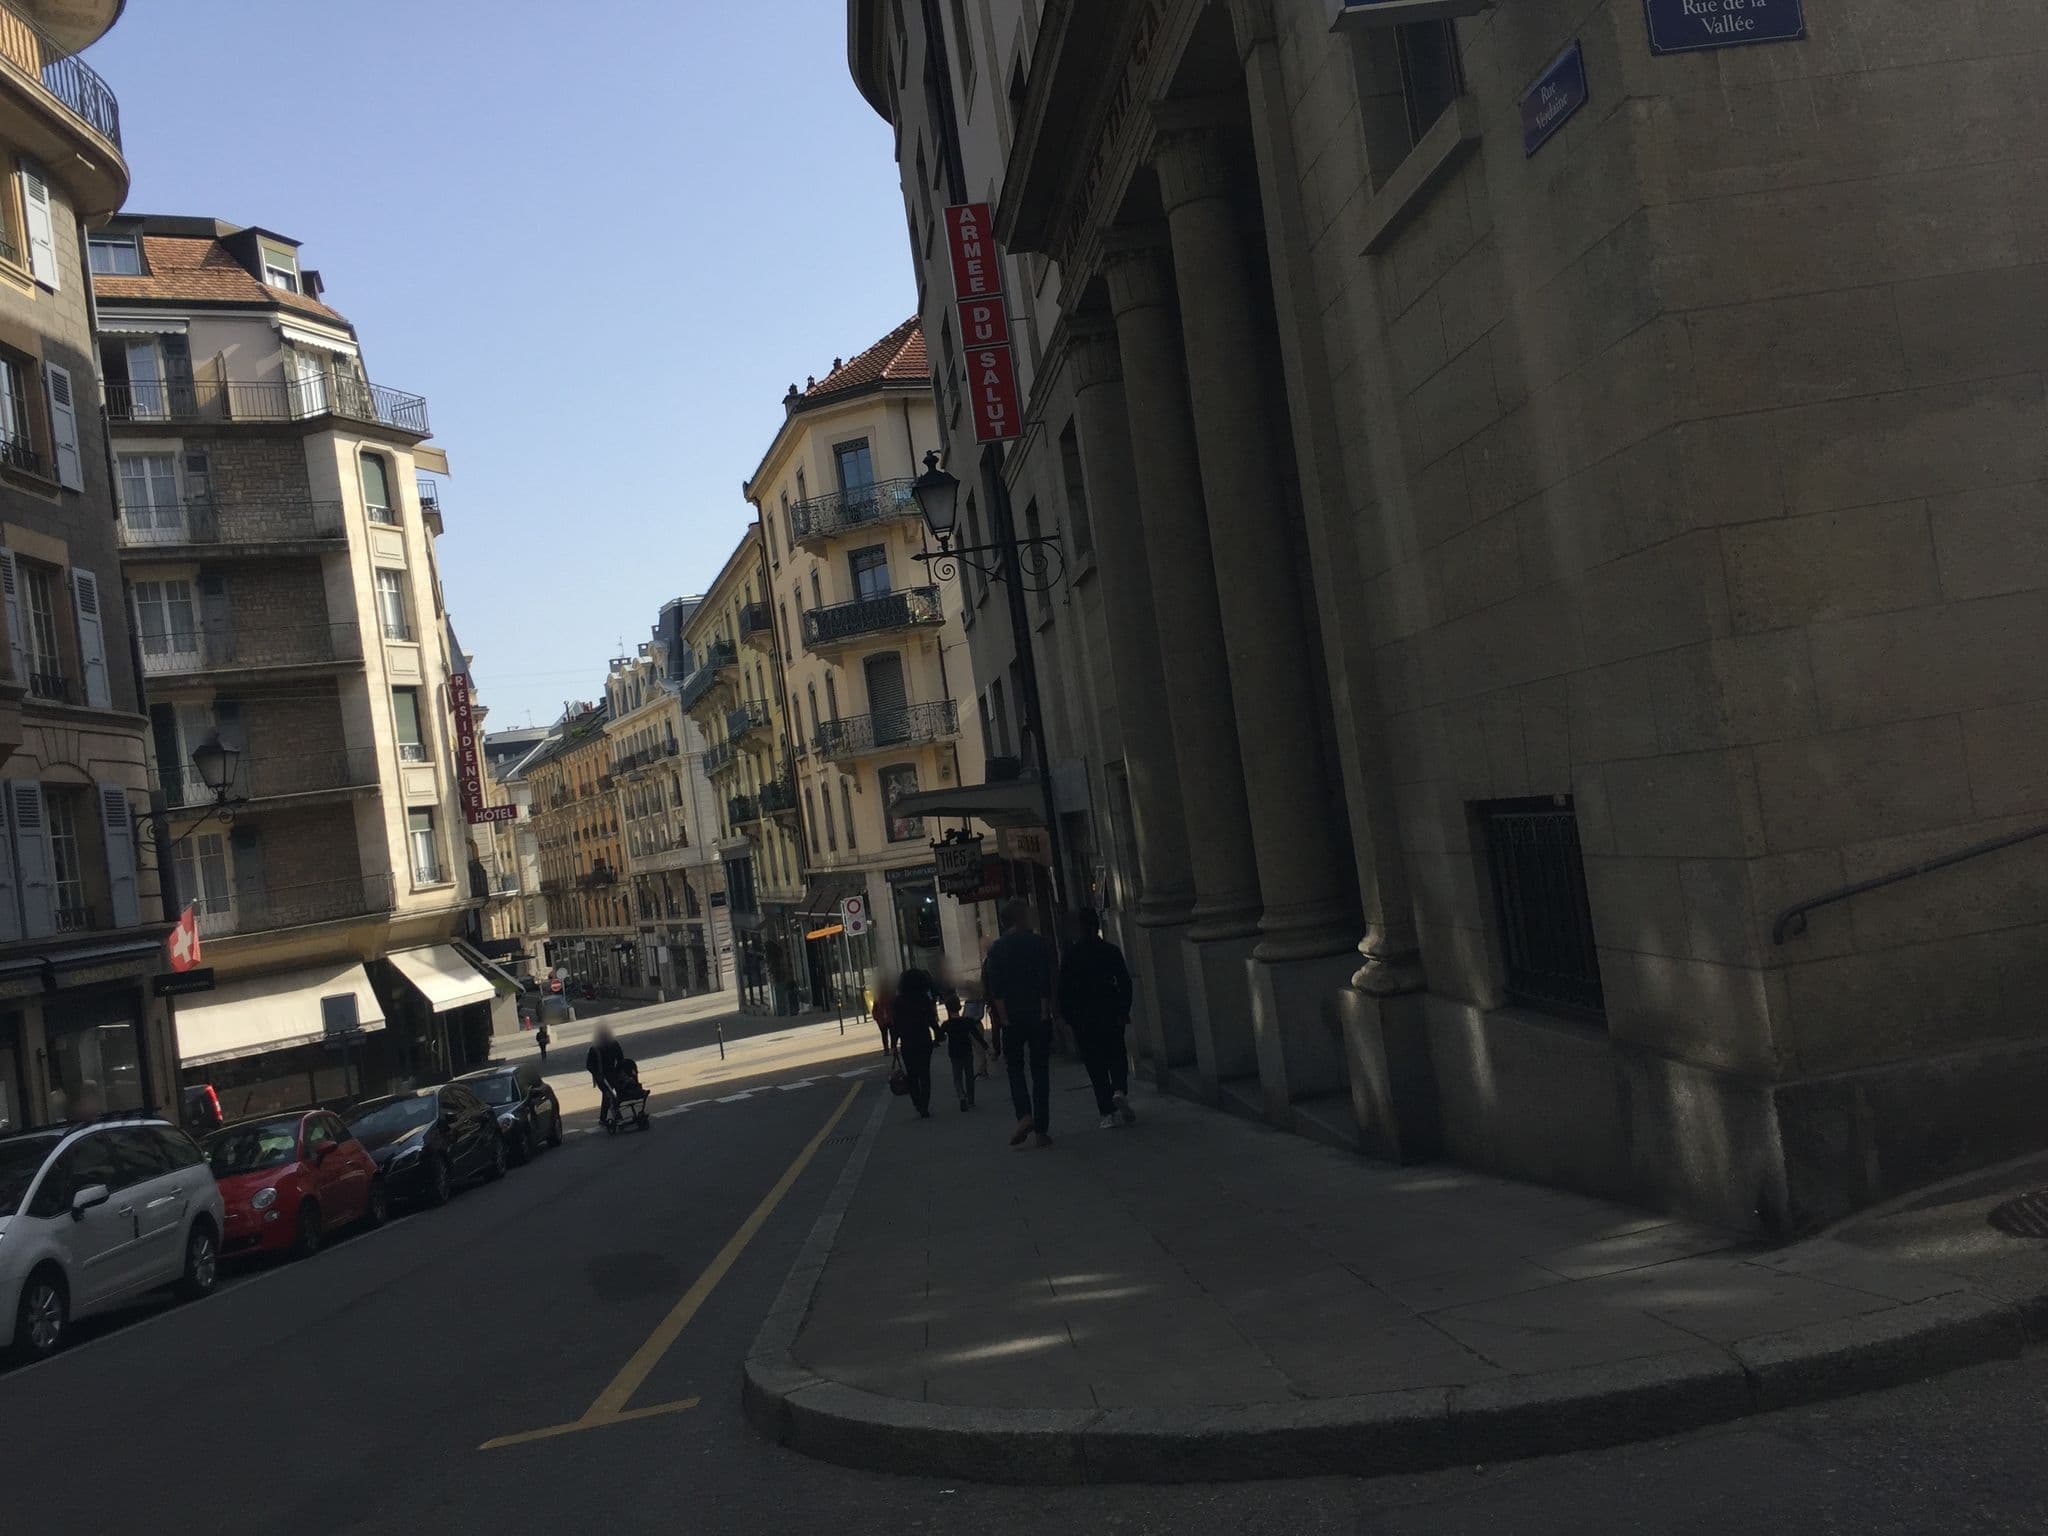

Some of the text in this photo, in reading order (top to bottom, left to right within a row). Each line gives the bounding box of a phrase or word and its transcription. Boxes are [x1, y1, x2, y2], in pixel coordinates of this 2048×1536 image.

[1682, 0, 1717, 15] Rue
[1700, 14, 1755, 34] Vallée
[1541, 81, 1556, 104] Rue
[1535, 93, 1568, 128] Verdaine
[973, 306, 993, 340] DU
[980, 351, 1007, 437] SALUT
